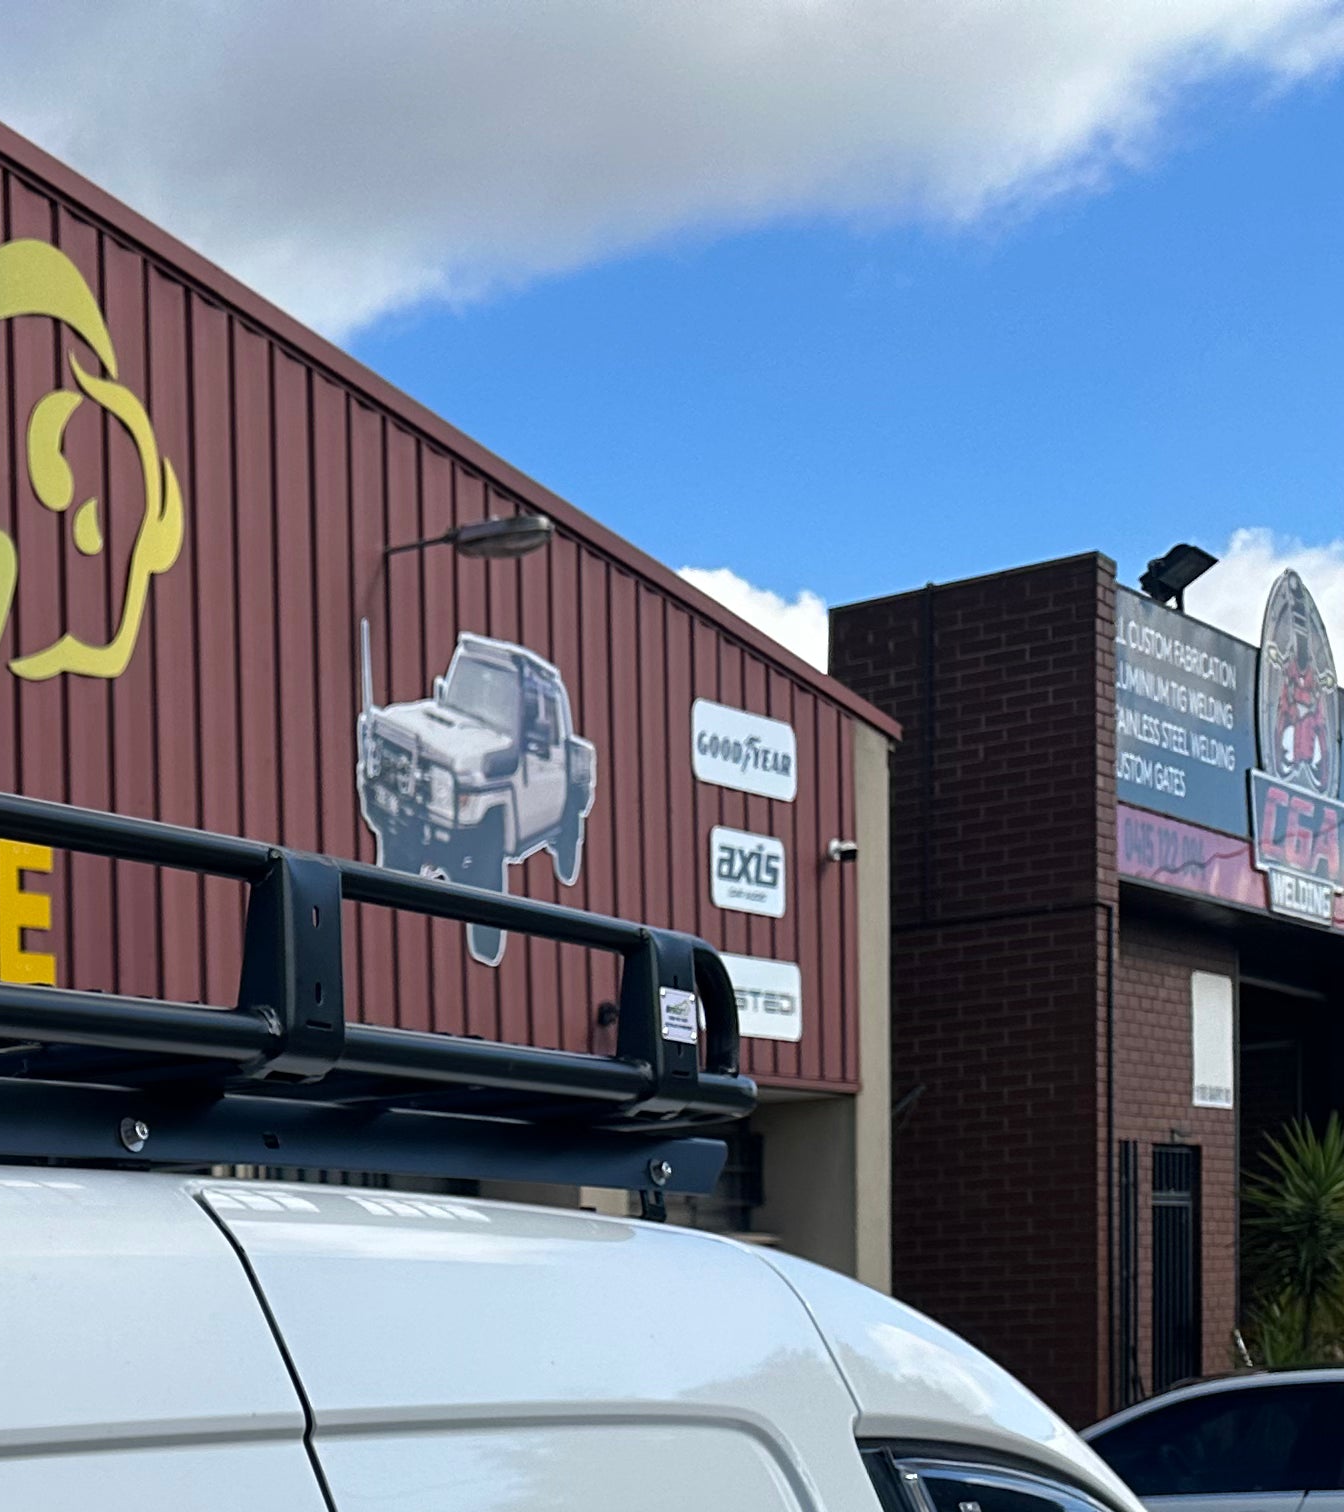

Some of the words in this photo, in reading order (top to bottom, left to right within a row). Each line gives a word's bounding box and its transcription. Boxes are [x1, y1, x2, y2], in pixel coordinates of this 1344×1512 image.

[1127, 620, 1173, 665] CUSTOM
[1173, 640, 1237, 691] FABRICATION
[1169, 681, 1187, 714] TIG
[1188, 691, 1234, 731] WELDING
[697, 730, 792, 777] GOODYEAR
[1161, 721, 1189, 757] STEEL
[1190, 732, 1236, 772] WELDING
[1153, 762, 1187, 798] GATES
[1261, 786, 1340, 880] CGA
[717, 843, 780, 889] axis
[1272, 872, 1332, 918] WELDING
